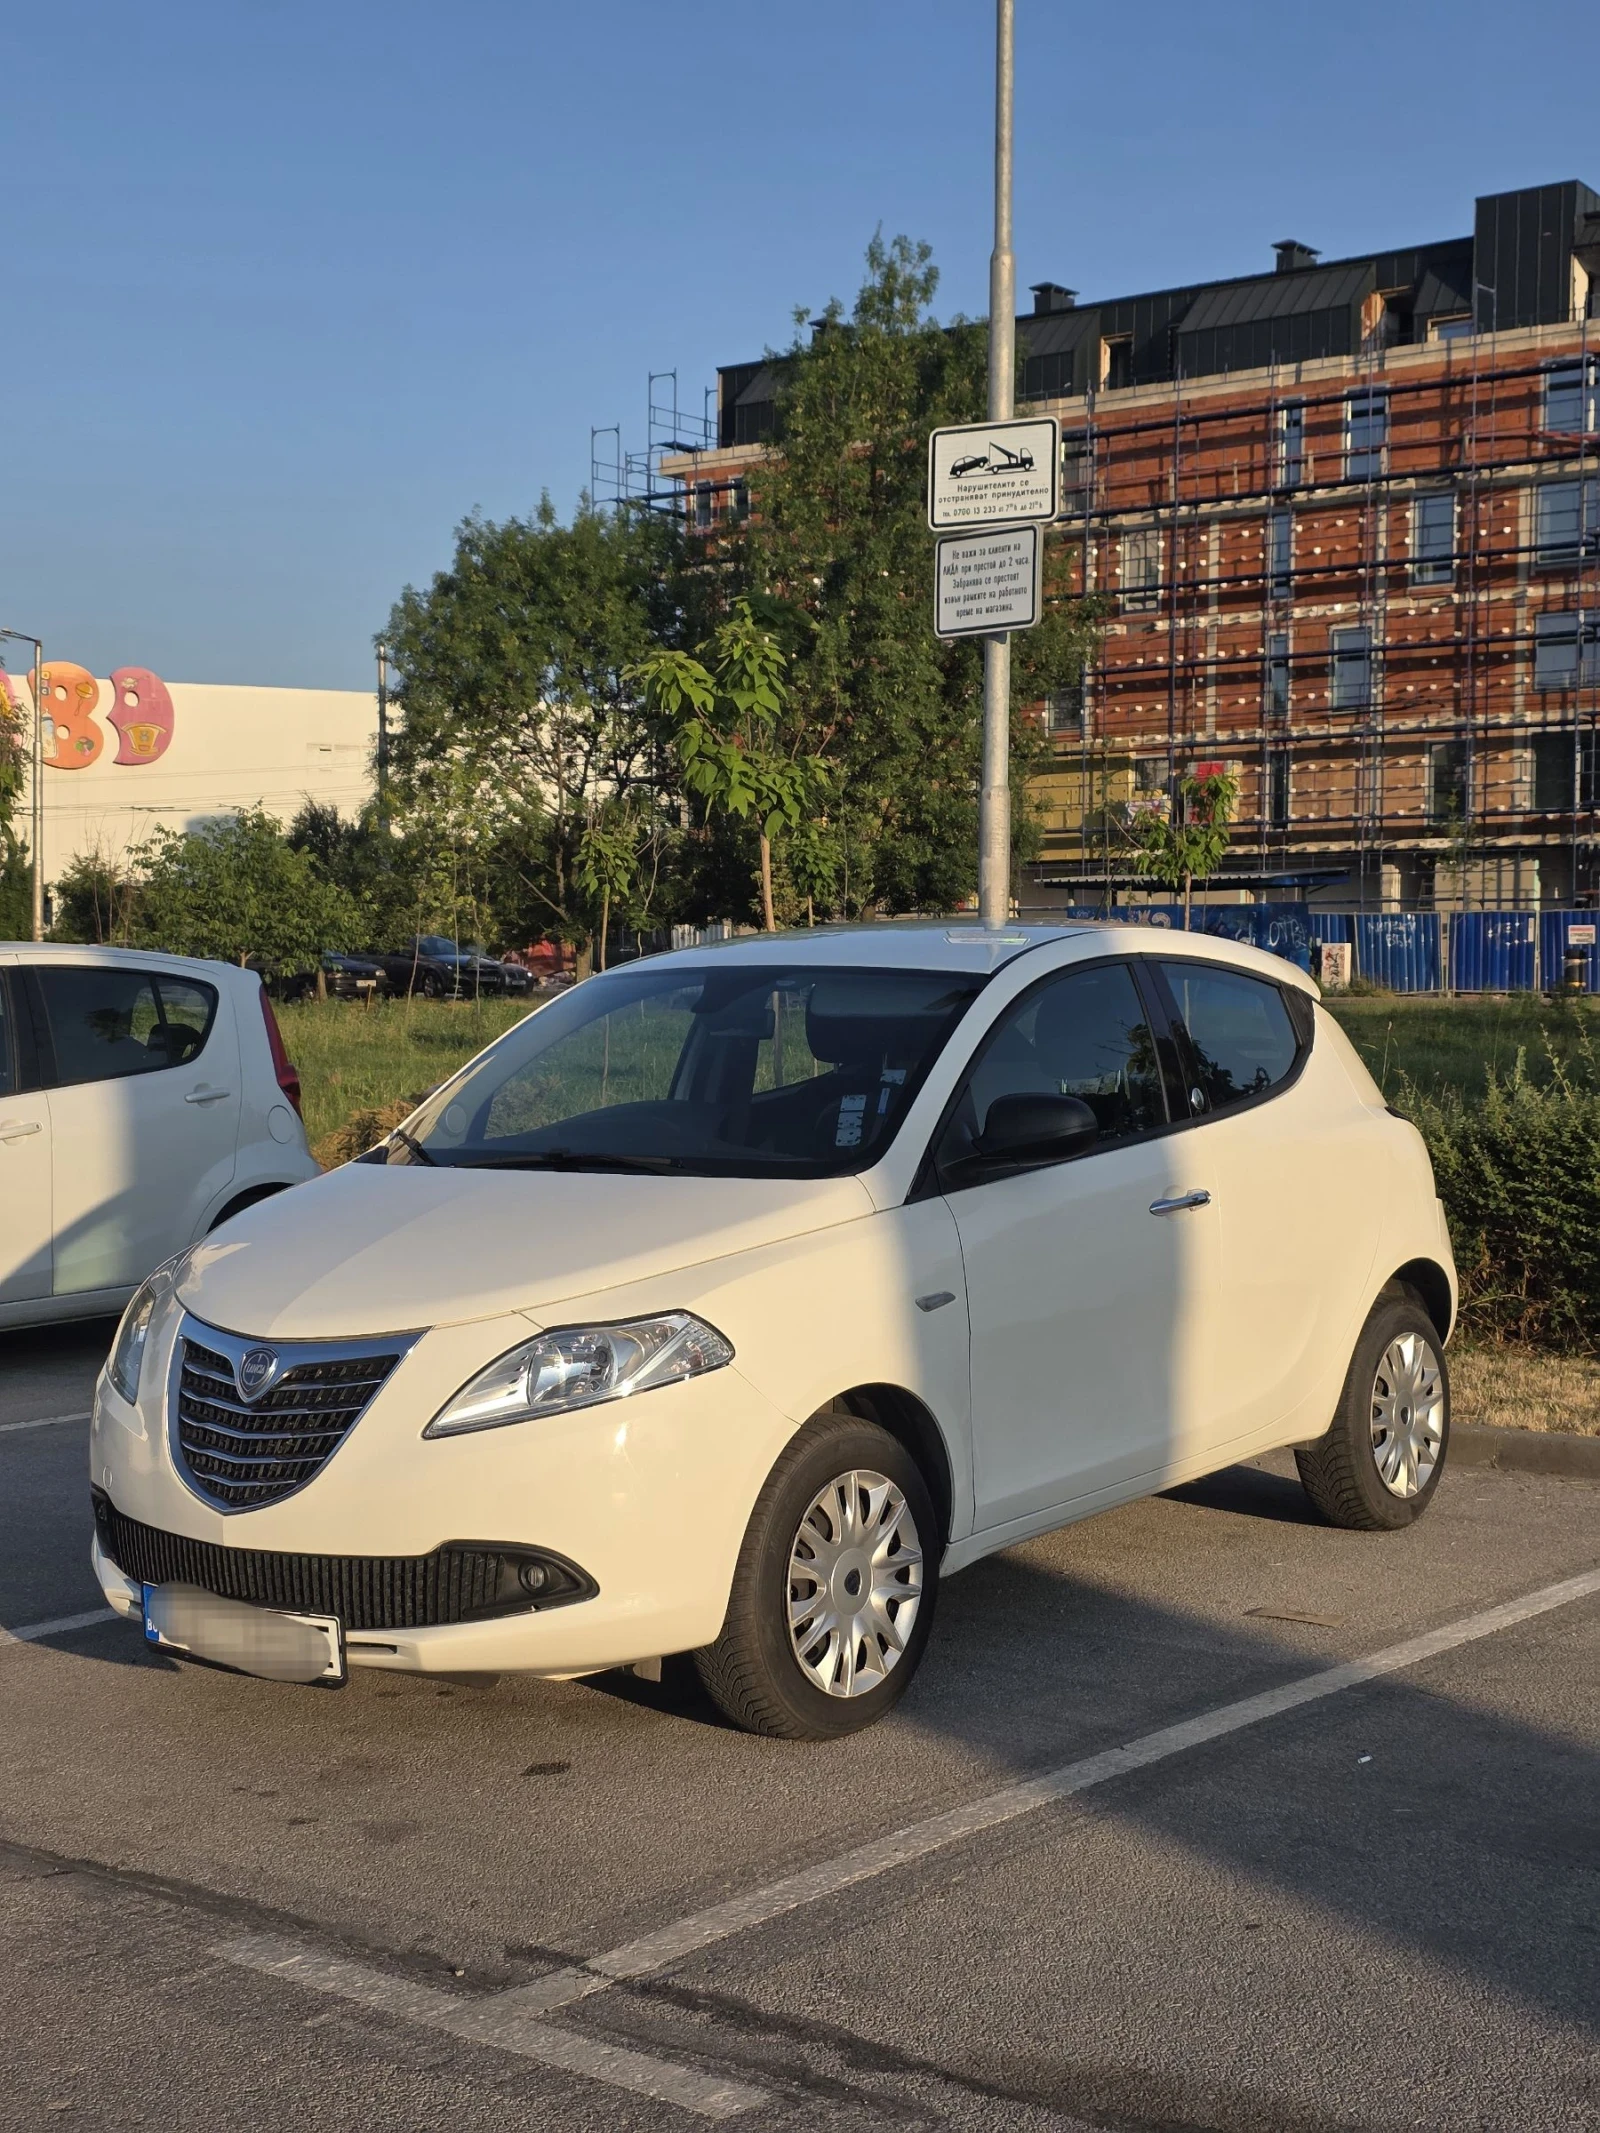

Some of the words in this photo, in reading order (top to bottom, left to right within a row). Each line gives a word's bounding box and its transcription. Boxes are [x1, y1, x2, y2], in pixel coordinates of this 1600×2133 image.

[957, 481, 1015, 492] Нарушителите
[938, 493, 988, 503] отстраняват
[992, 488, 1048, 499] принудително
[954, 508, 970, 516] 0700
[984, 506, 996, 514] 233
[952, 550, 959, 559] Не
[962, 550, 976, 558] важи
[988, 544, 1011, 555] клиенти
[1014, 543, 1020, 551] на
[961, 565, 971, 575] при
[974, 560, 996, 574] престой
[999, 560, 1006, 569] до
[1009, 557, 1013, 567] 2
[953, 578, 982, 590] Забранява
[994, 572, 1019, 585] престоят
[945, 596, 961, 604] извън
[963, 592, 986, 604] рамките
[999, 586, 1027, 600] работното
[956, 608, 973, 619] време
